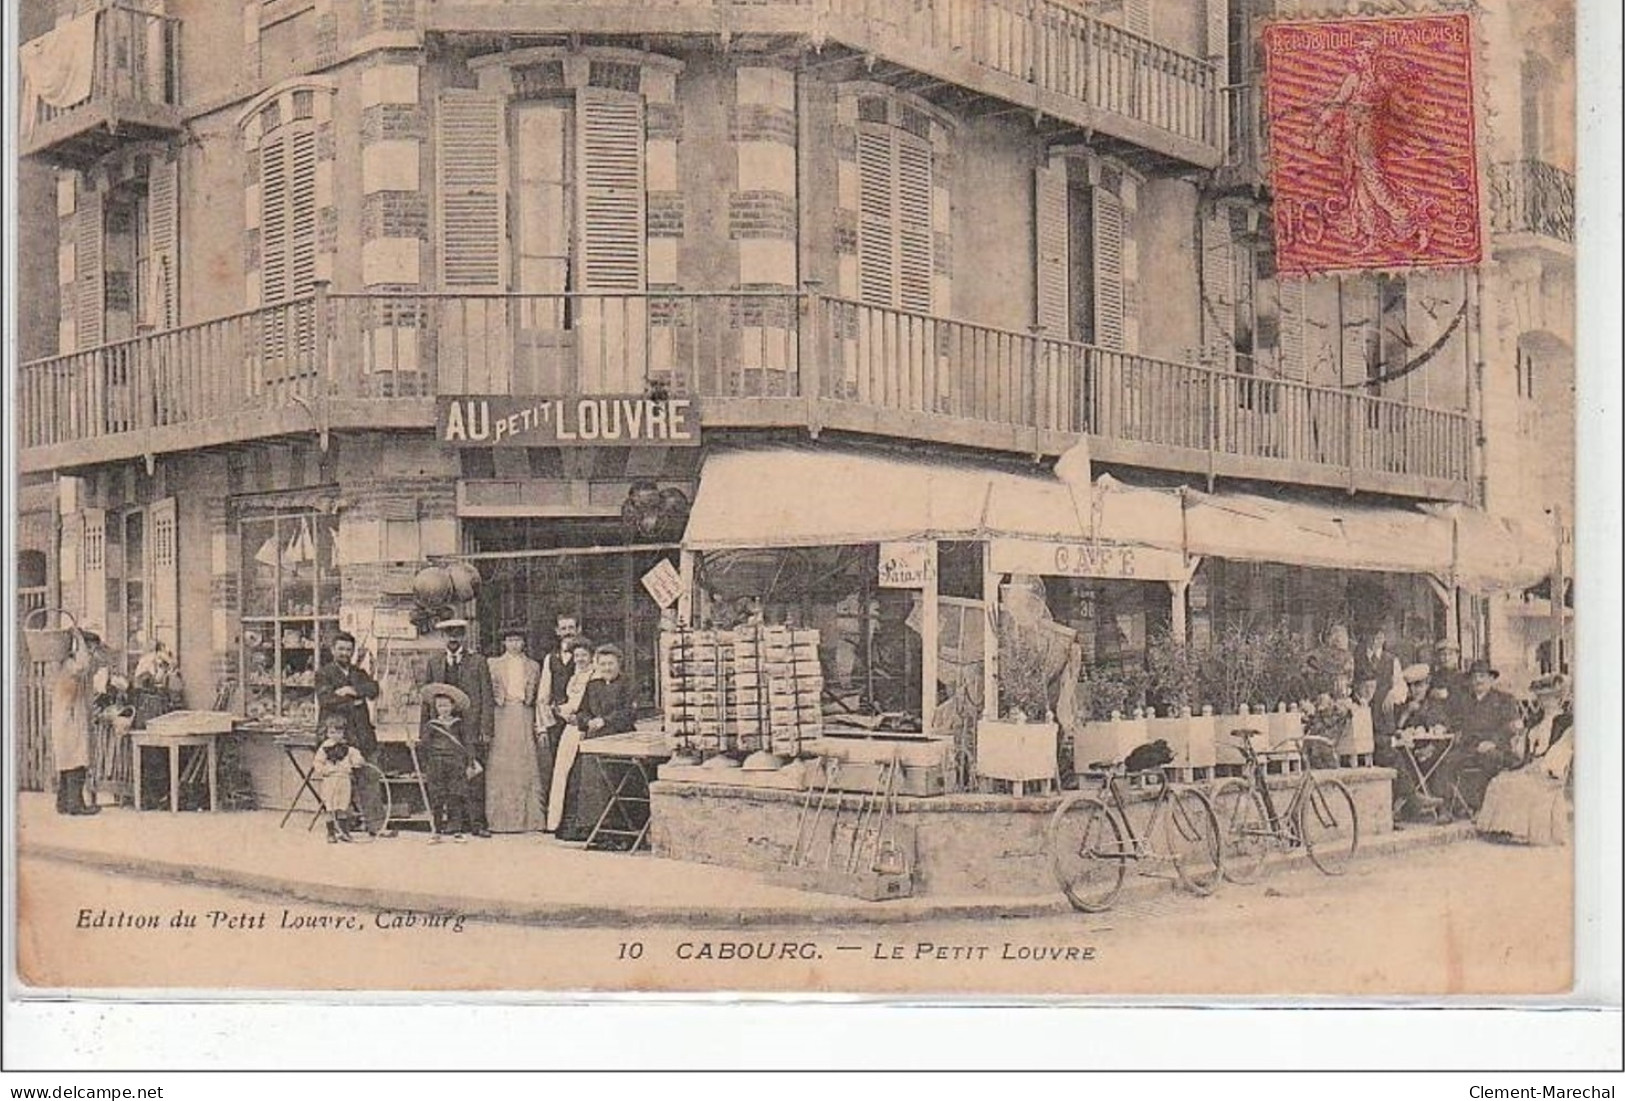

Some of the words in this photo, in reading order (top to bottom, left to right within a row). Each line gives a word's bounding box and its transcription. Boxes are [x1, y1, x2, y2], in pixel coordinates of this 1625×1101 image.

[445, 401, 489, 441] AU
[492, 401, 551, 444] PETIT
[555, 400, 691, 439] LOUVRE
